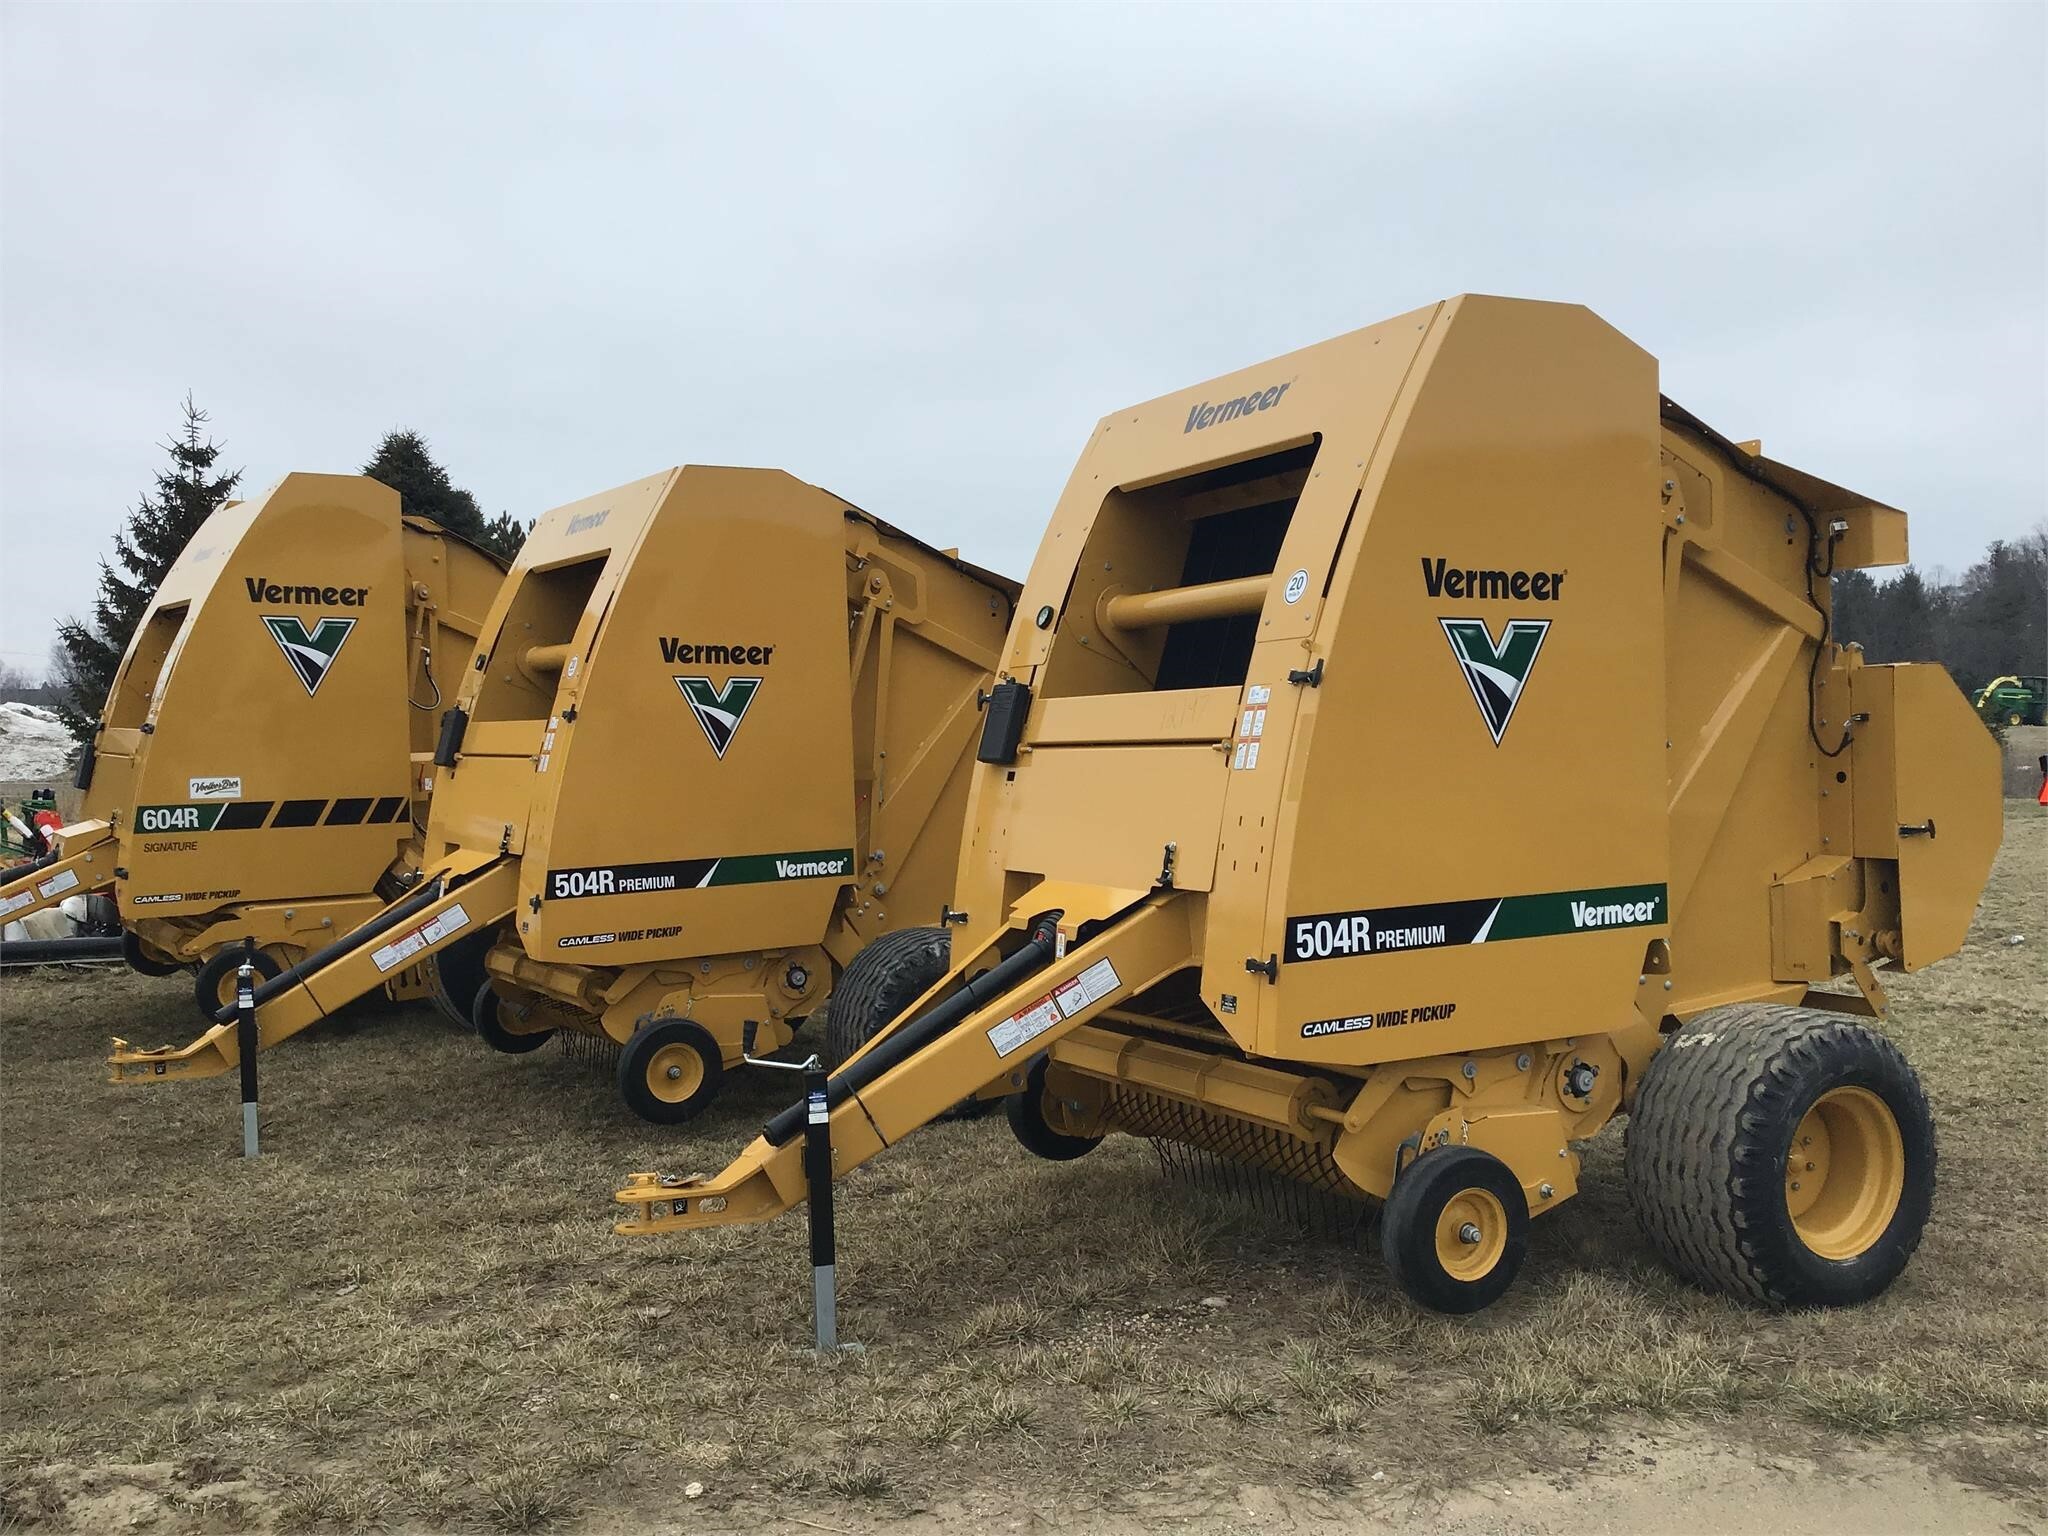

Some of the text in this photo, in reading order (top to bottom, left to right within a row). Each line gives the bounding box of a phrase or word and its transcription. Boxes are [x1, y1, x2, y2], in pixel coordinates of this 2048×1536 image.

[1183, 382, 1291, 434] Vermeer
[245, 577, 369, 607] Vermeer
[1289, 575, 1304, 591] 20
[1421, 557, 1564, 601] Vermeer
[658, 636, 773, 665] Vermeer
[142, 807, 200, 830] 604R
[143, 841, 198, 853] SIGNATURE
[775, 859, 844, 878] Vermeer
[134, 889, 241, 904] CAMLESS WIDE PICKUP
[555, 869, 675, 898] 504R PREMIUM
[1570, 900, 1655, 928] Vermeer
[559, 926, 683, 947] CAMLESS WIDE PICKUP
[1296, 916, 1446, 959] 504R PREMIUM
[1302, 1003, 1456, 1037] CAMLESS WIDE PICKUP
